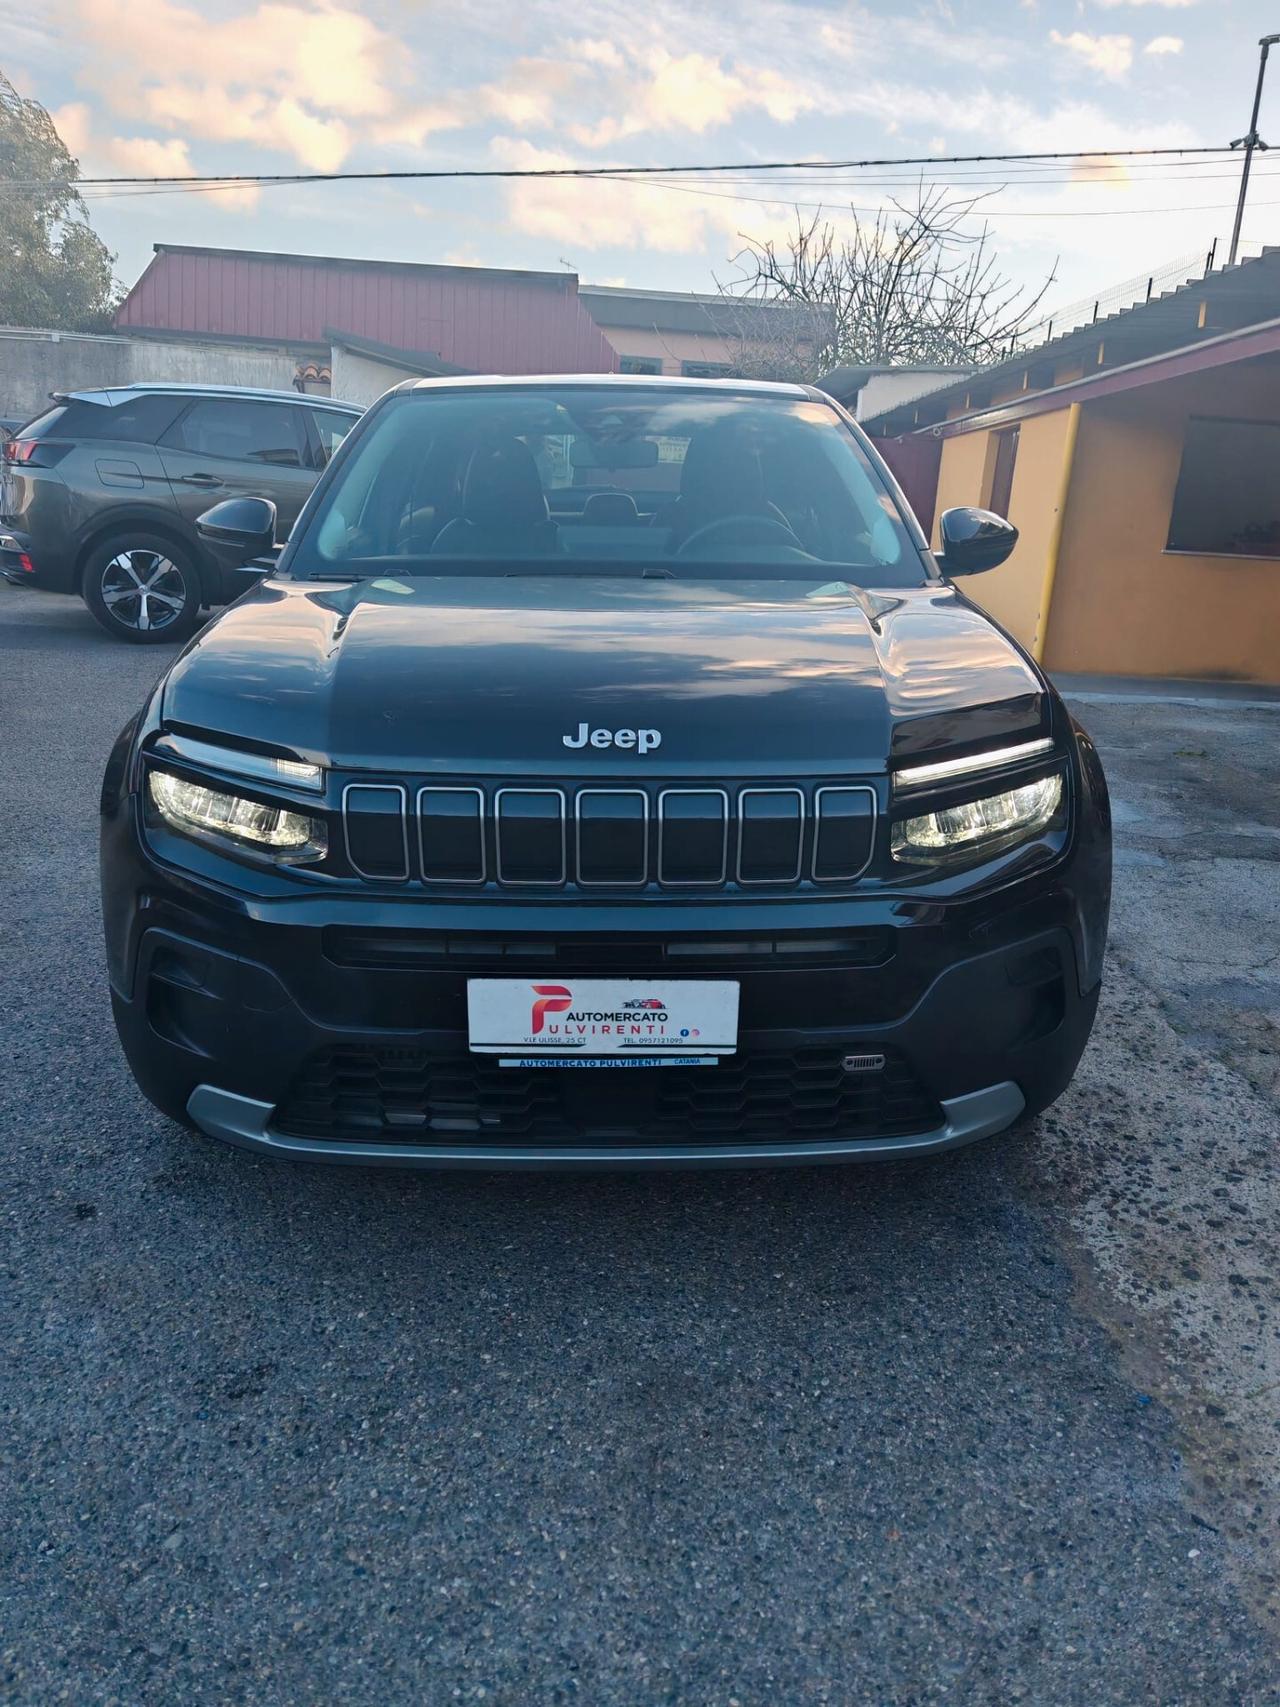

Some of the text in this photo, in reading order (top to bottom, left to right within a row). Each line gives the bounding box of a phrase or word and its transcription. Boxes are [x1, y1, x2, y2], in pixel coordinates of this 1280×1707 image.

[562, 723, 662, 754] Jeep
[566, 1012, 668, 1022] AUTOMERCATO
[519, 1057, 702, 1068] AUTOMERCATO PULVIRENTI CATANIA
